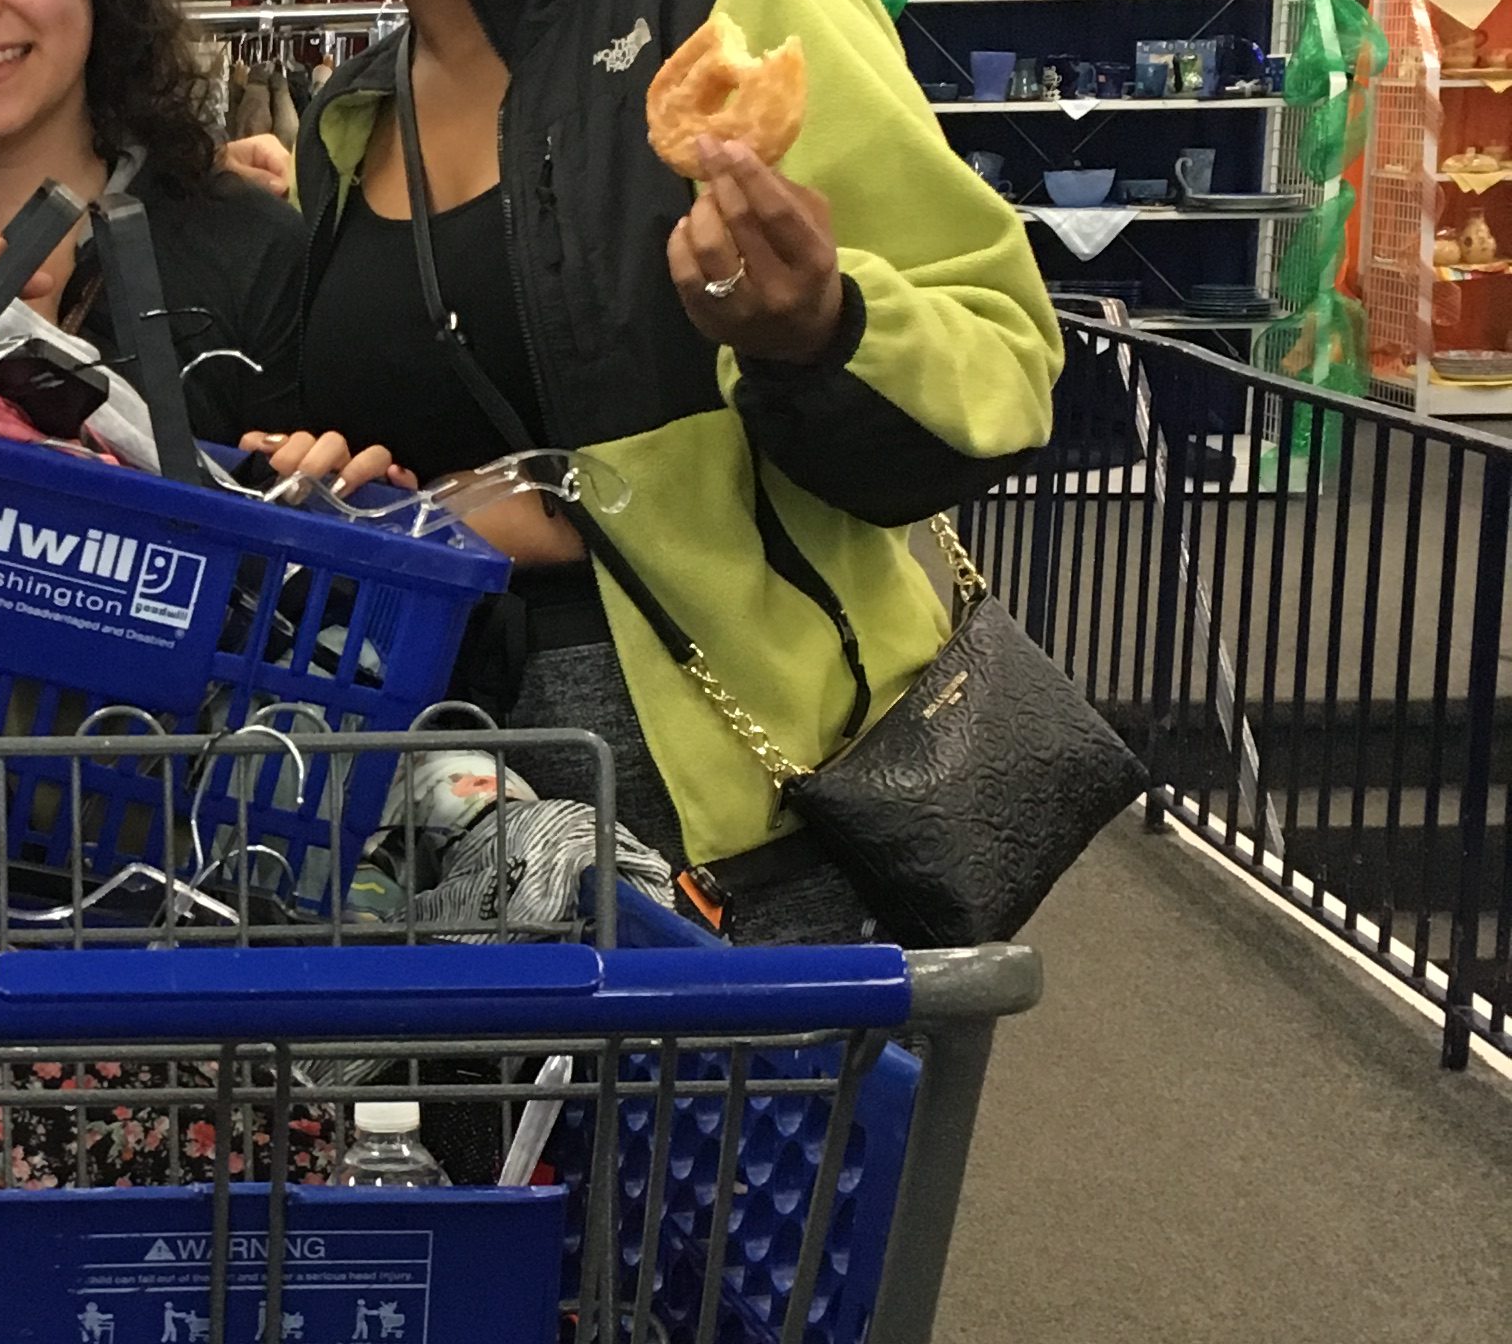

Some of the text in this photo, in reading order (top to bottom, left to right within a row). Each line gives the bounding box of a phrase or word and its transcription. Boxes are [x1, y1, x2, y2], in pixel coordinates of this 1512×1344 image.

[134, 602, 189, 622] goodwill
[101, 619, 125, 638] and
[126, 628, 176, 649] Disabled
[176, 1236, 326, 1260] WRNNG
[349, 1271, 377, 1281] head
